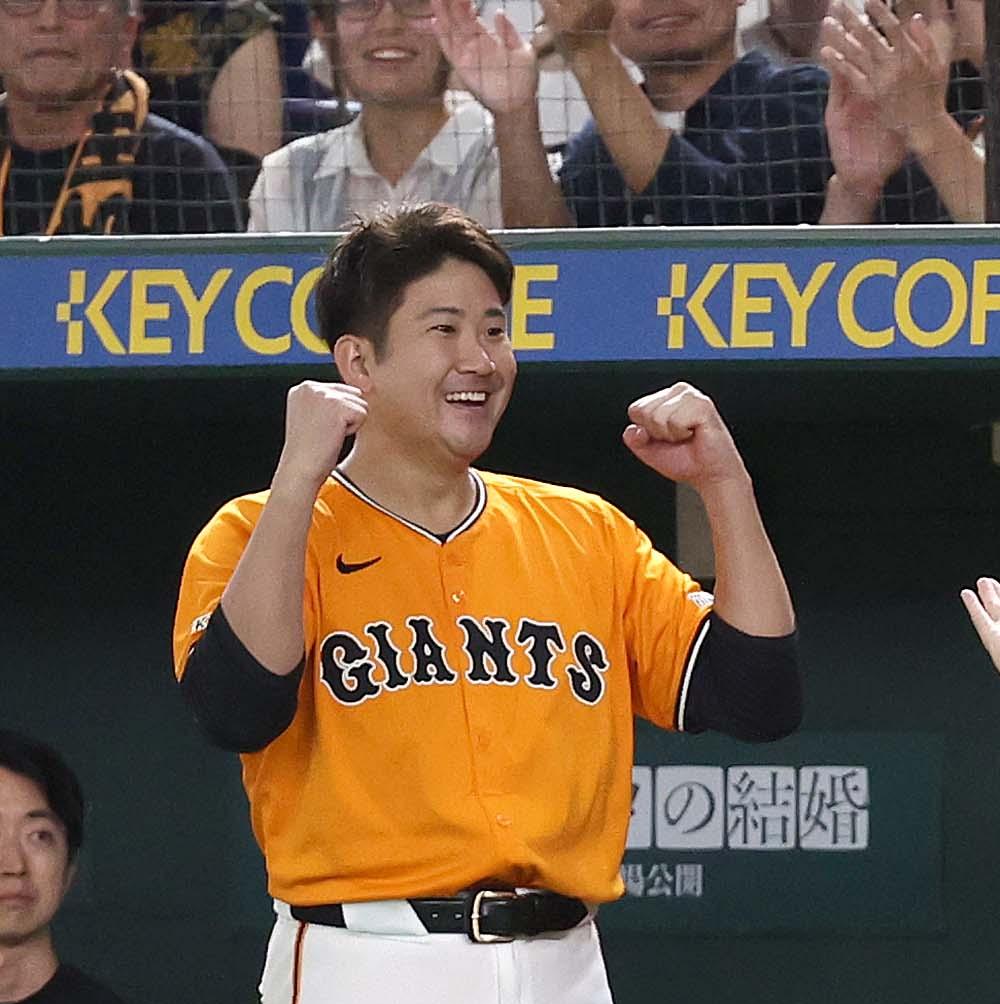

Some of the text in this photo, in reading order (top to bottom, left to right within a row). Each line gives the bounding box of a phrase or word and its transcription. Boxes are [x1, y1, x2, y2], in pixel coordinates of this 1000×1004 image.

[319, 614, 610, 706] GIANTS
[629, 767, 868, 849] の結婚
